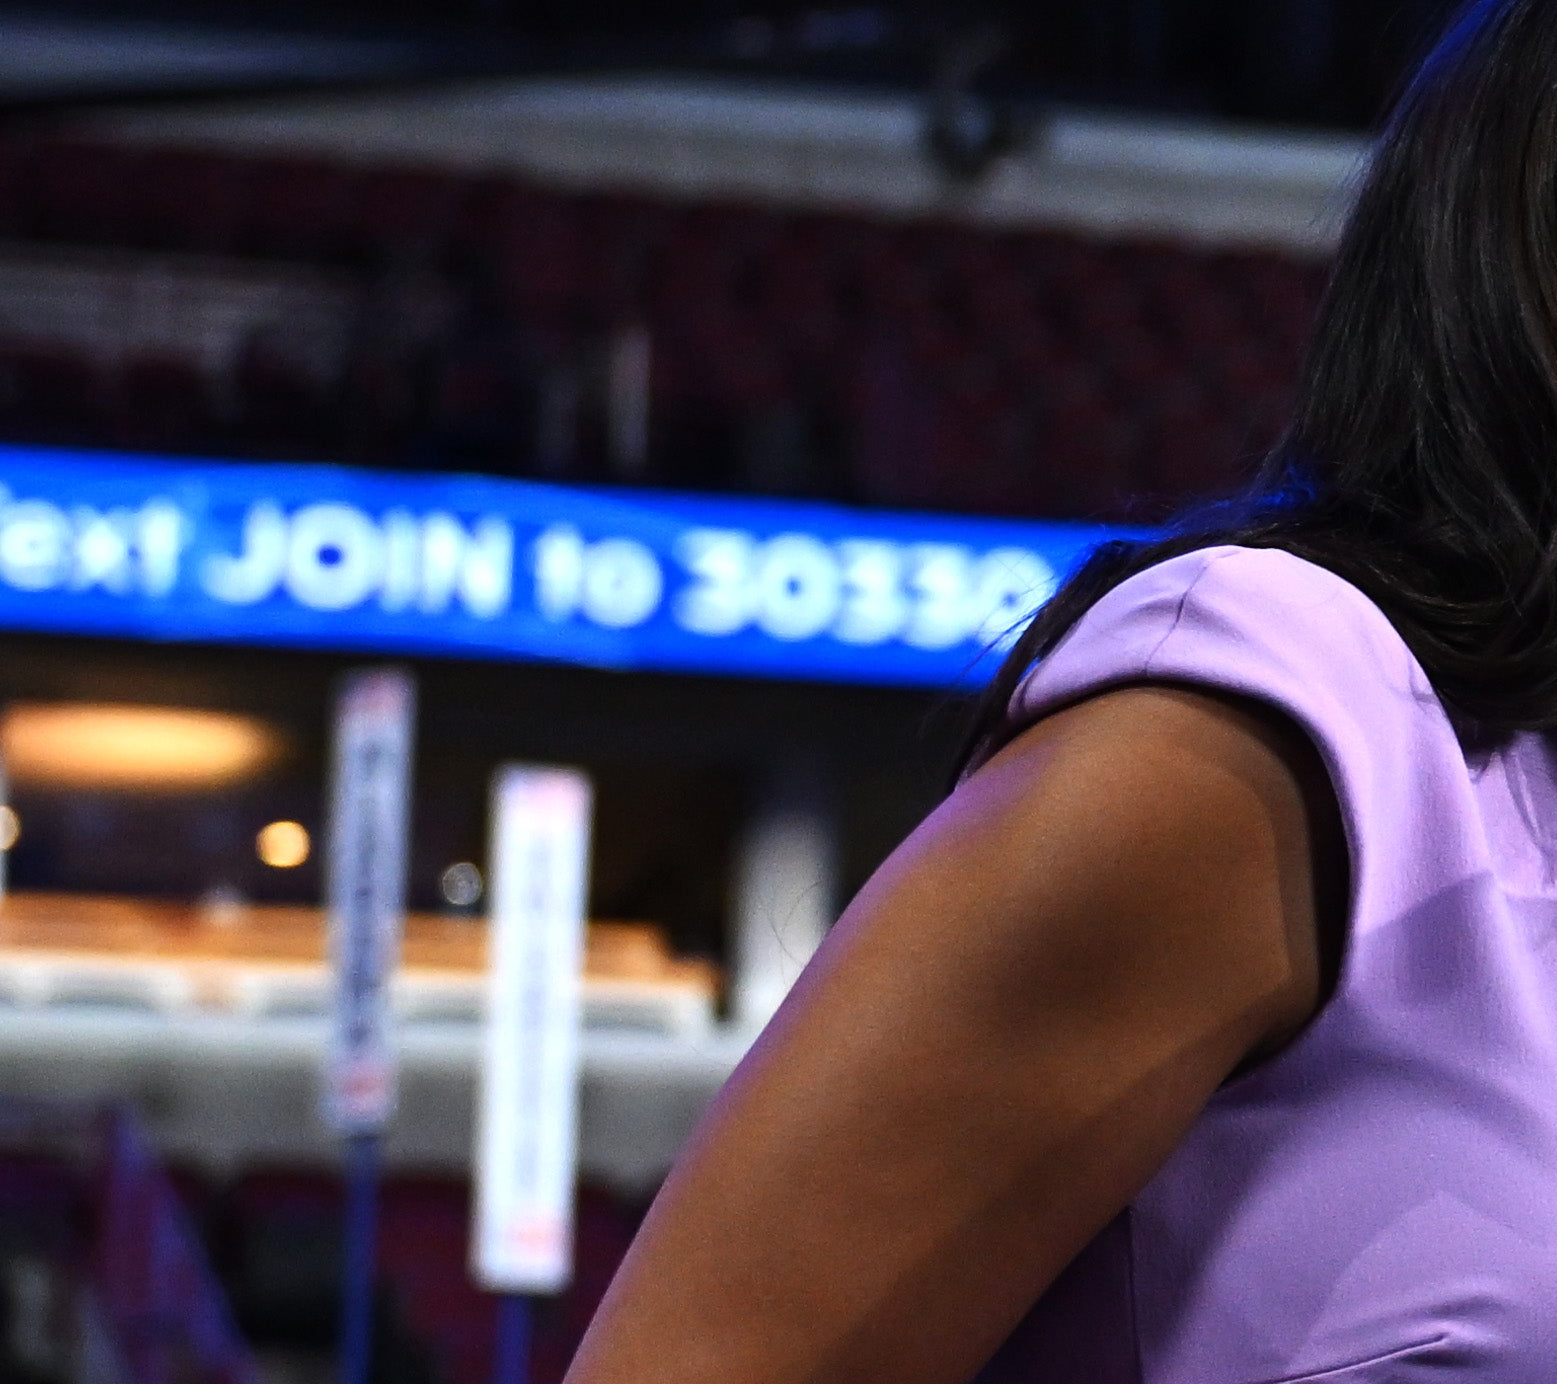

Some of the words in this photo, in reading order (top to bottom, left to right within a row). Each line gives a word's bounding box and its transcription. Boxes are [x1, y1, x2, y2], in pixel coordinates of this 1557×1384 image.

[0, 484, 188, 596] ext
[205, 500, 512, 616] JOIN
[536, 522, 662, 628] to
[678, 528, 1062, 652] 30330
